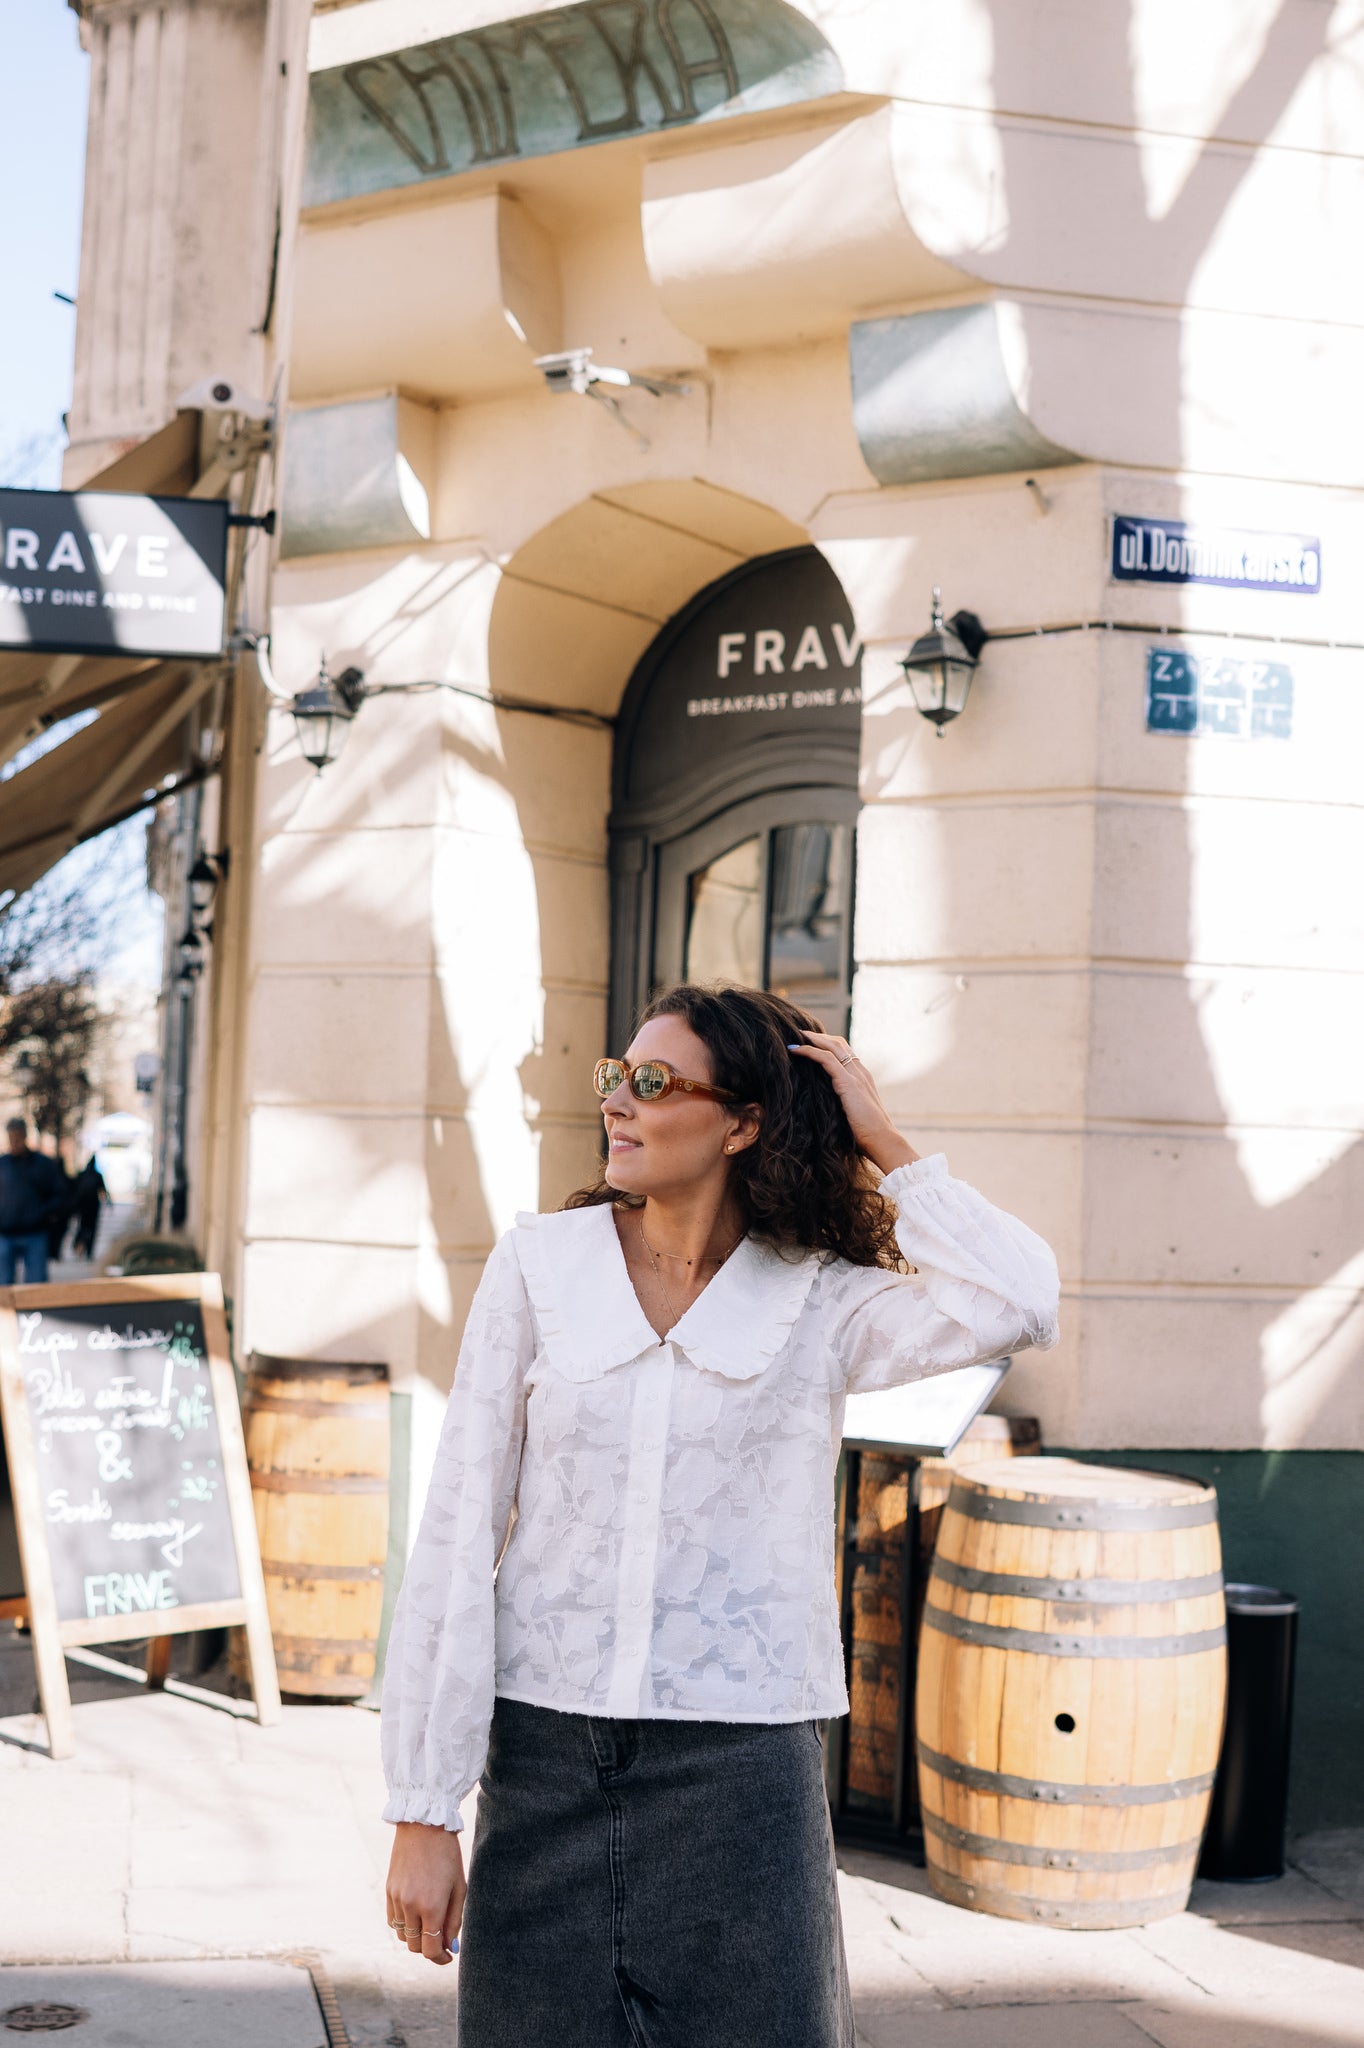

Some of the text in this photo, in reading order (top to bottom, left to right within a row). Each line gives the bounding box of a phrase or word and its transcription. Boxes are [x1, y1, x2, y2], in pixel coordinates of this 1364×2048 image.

[4, 527, 170, 578] RAVE
[51, 588, 97, 607] DINE
[103, 592, 143, 610] AND
[150, 595, 198, 613] WINE
[716, 622, 862, 679] FRAV
[687, 692, 789, 717] BREAKFAST
[792, 687, 837, 709] DINE
[83, 1568, 180, 1619] FRAVE
